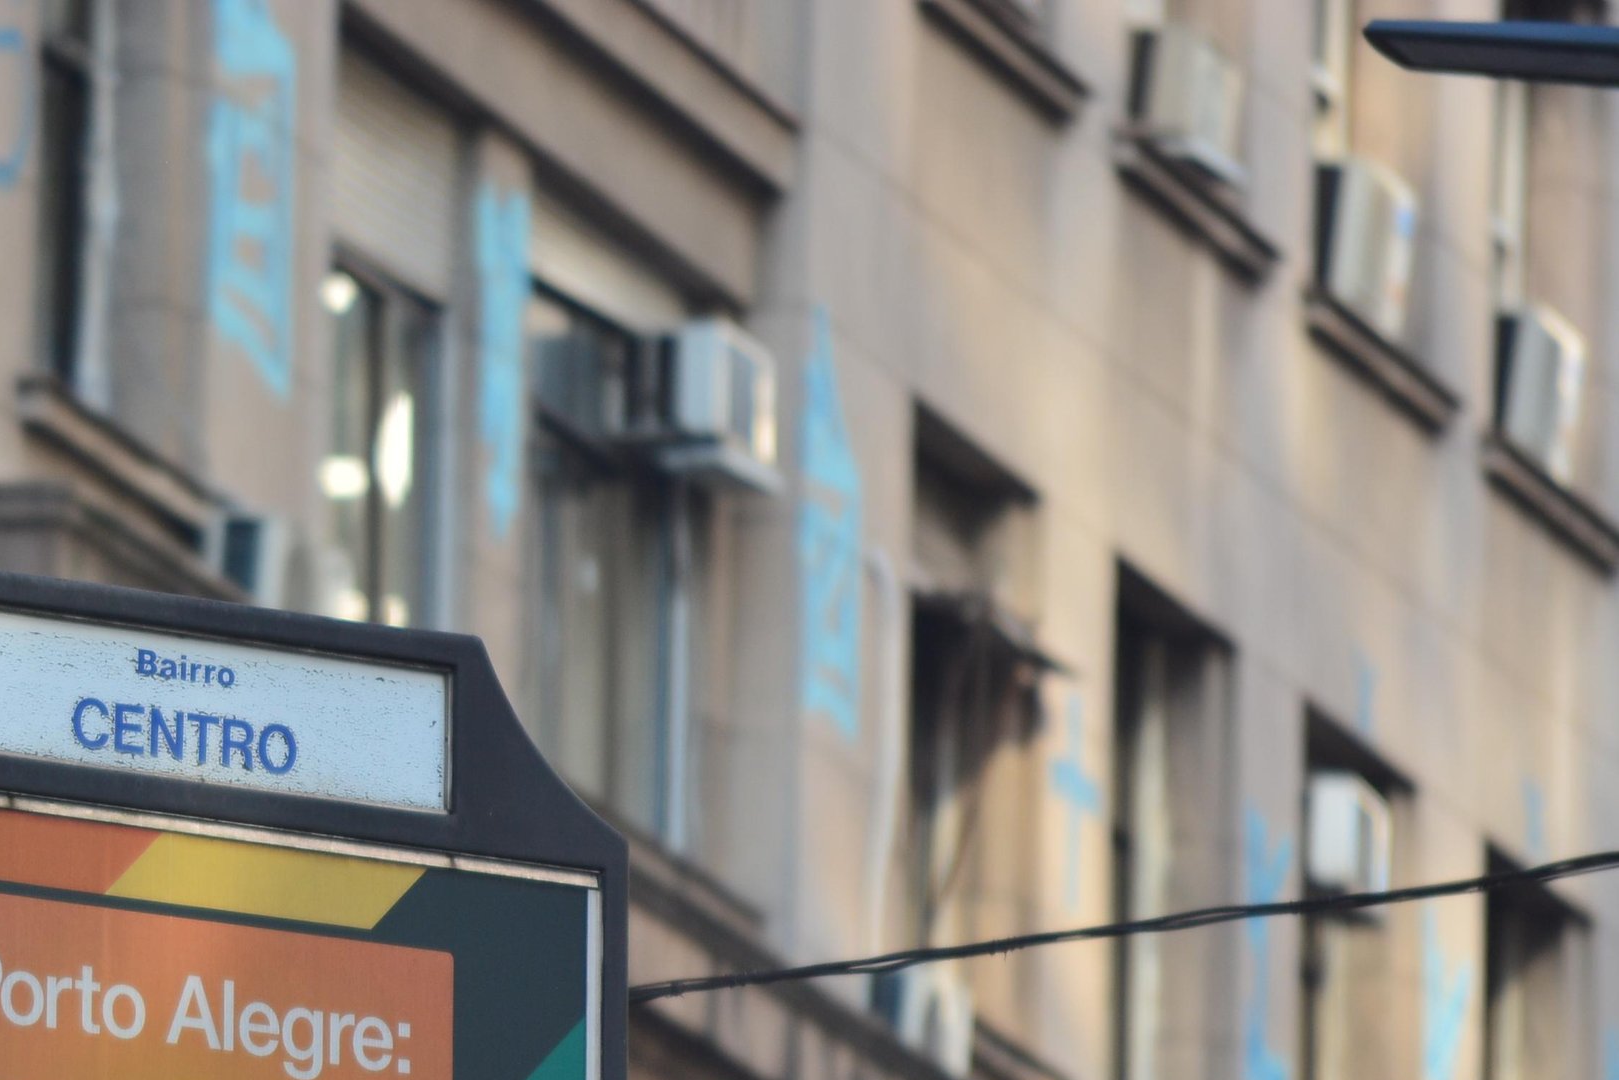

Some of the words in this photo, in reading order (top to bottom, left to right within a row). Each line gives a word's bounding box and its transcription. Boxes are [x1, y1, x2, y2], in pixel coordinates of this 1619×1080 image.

[136, 648, 235, 687] Bairro
[72, 697, 297, 775] CENTRO
[166, 974, 411, 1080] Alegre:
